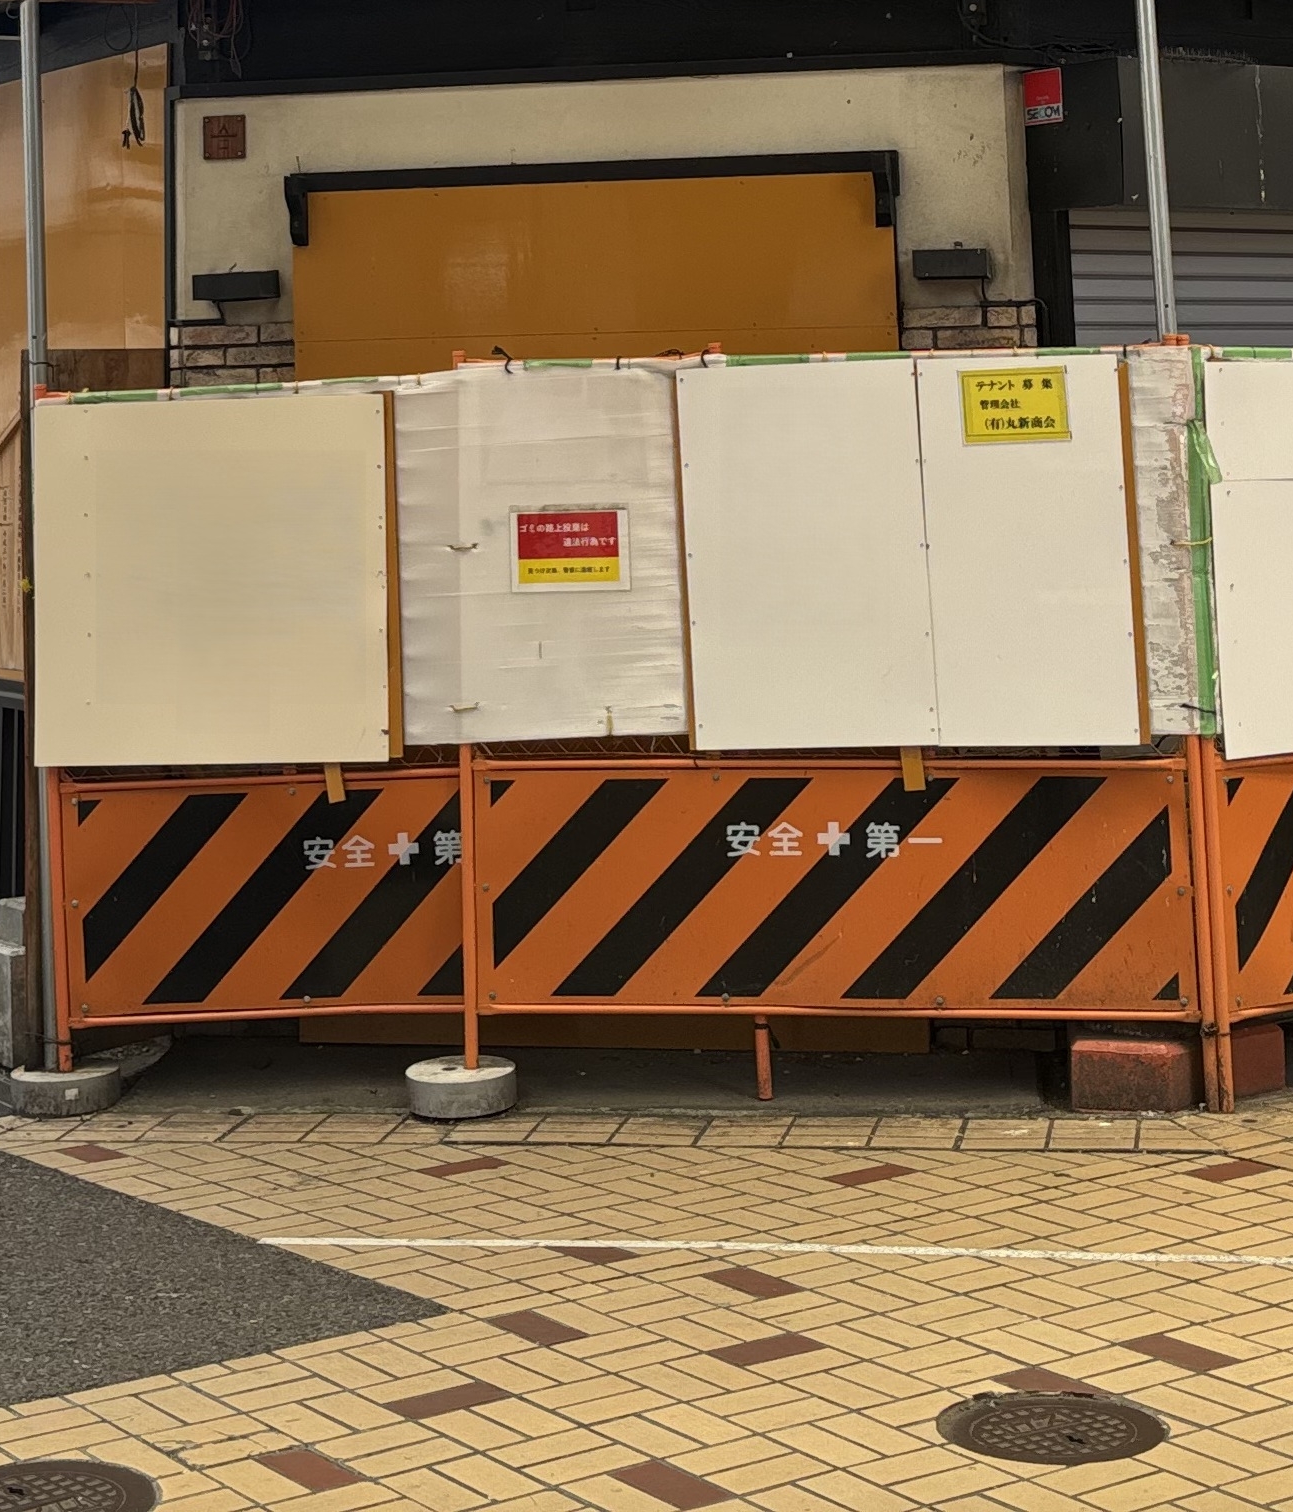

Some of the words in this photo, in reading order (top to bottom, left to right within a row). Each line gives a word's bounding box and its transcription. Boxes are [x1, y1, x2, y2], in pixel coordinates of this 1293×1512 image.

[980, 398, 1022, 410] 管理会社
[302, 835, 376, 870] 安全
